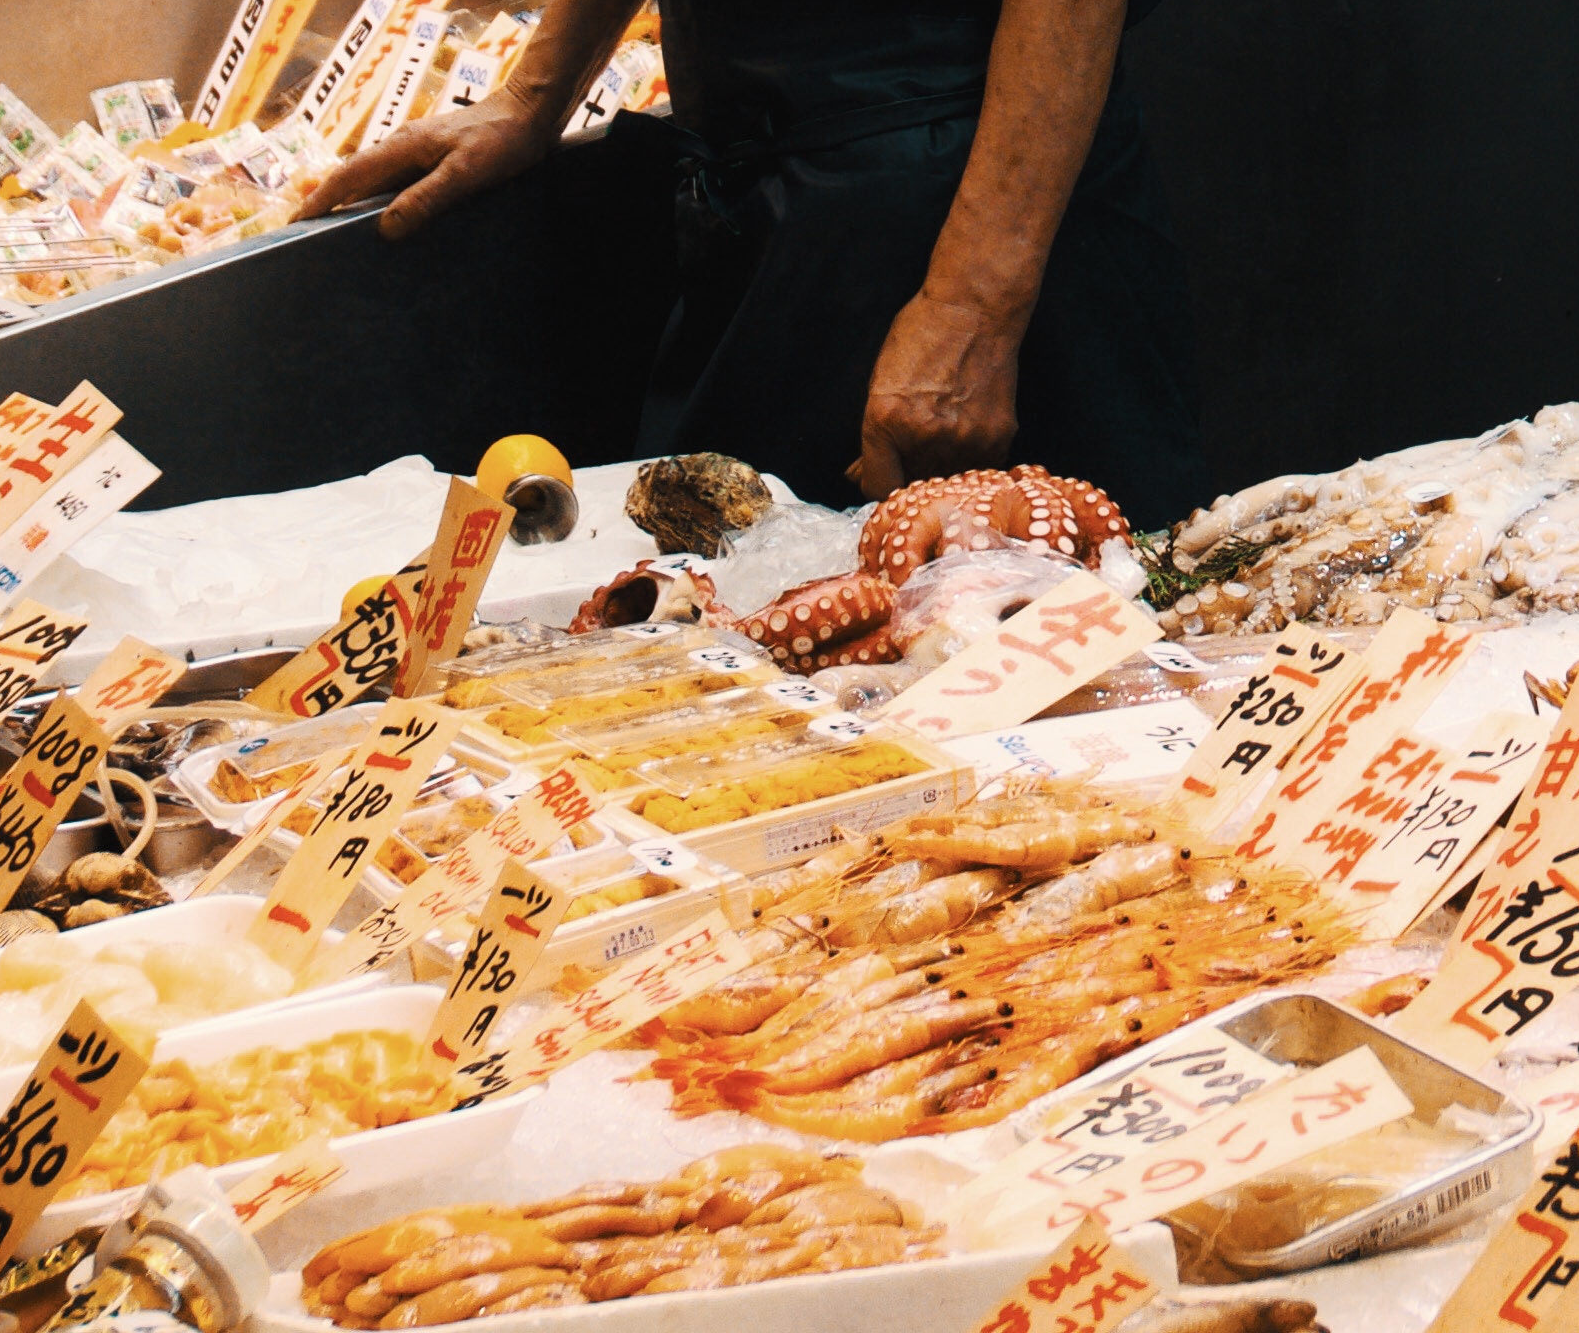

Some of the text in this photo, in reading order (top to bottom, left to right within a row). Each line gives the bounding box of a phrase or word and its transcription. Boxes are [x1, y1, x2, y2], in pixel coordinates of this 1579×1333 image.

[457, 62, 487, 87] ¥600
[1275, 641, 1345, 674] 一ツ
[1216, 674, 1304, 731] ¥250
[24, 713, 98, 797] 100g
[379, 716, 439, 757] 一ツ
[1221, 739, 1273, 776] 円
[310, 767, 394, 837] ¥180
[1381, 785, 1478, 851] ¥130
[327, 836, 370, 879] 円
[1414, 837, 1460, 872] 円
[500, 883, 553, 920] 一ツ
[449, 926, 517, 1000] ¥130
[461, 1004, 499, 1047] 円
[1482, 987, 1554, 1039] 円
[54, 1030, 122, 1084] 一ツ
[1057, 1080, 1191, 1149] ¥300
[1053, 1153, 1125, 1181] 円
